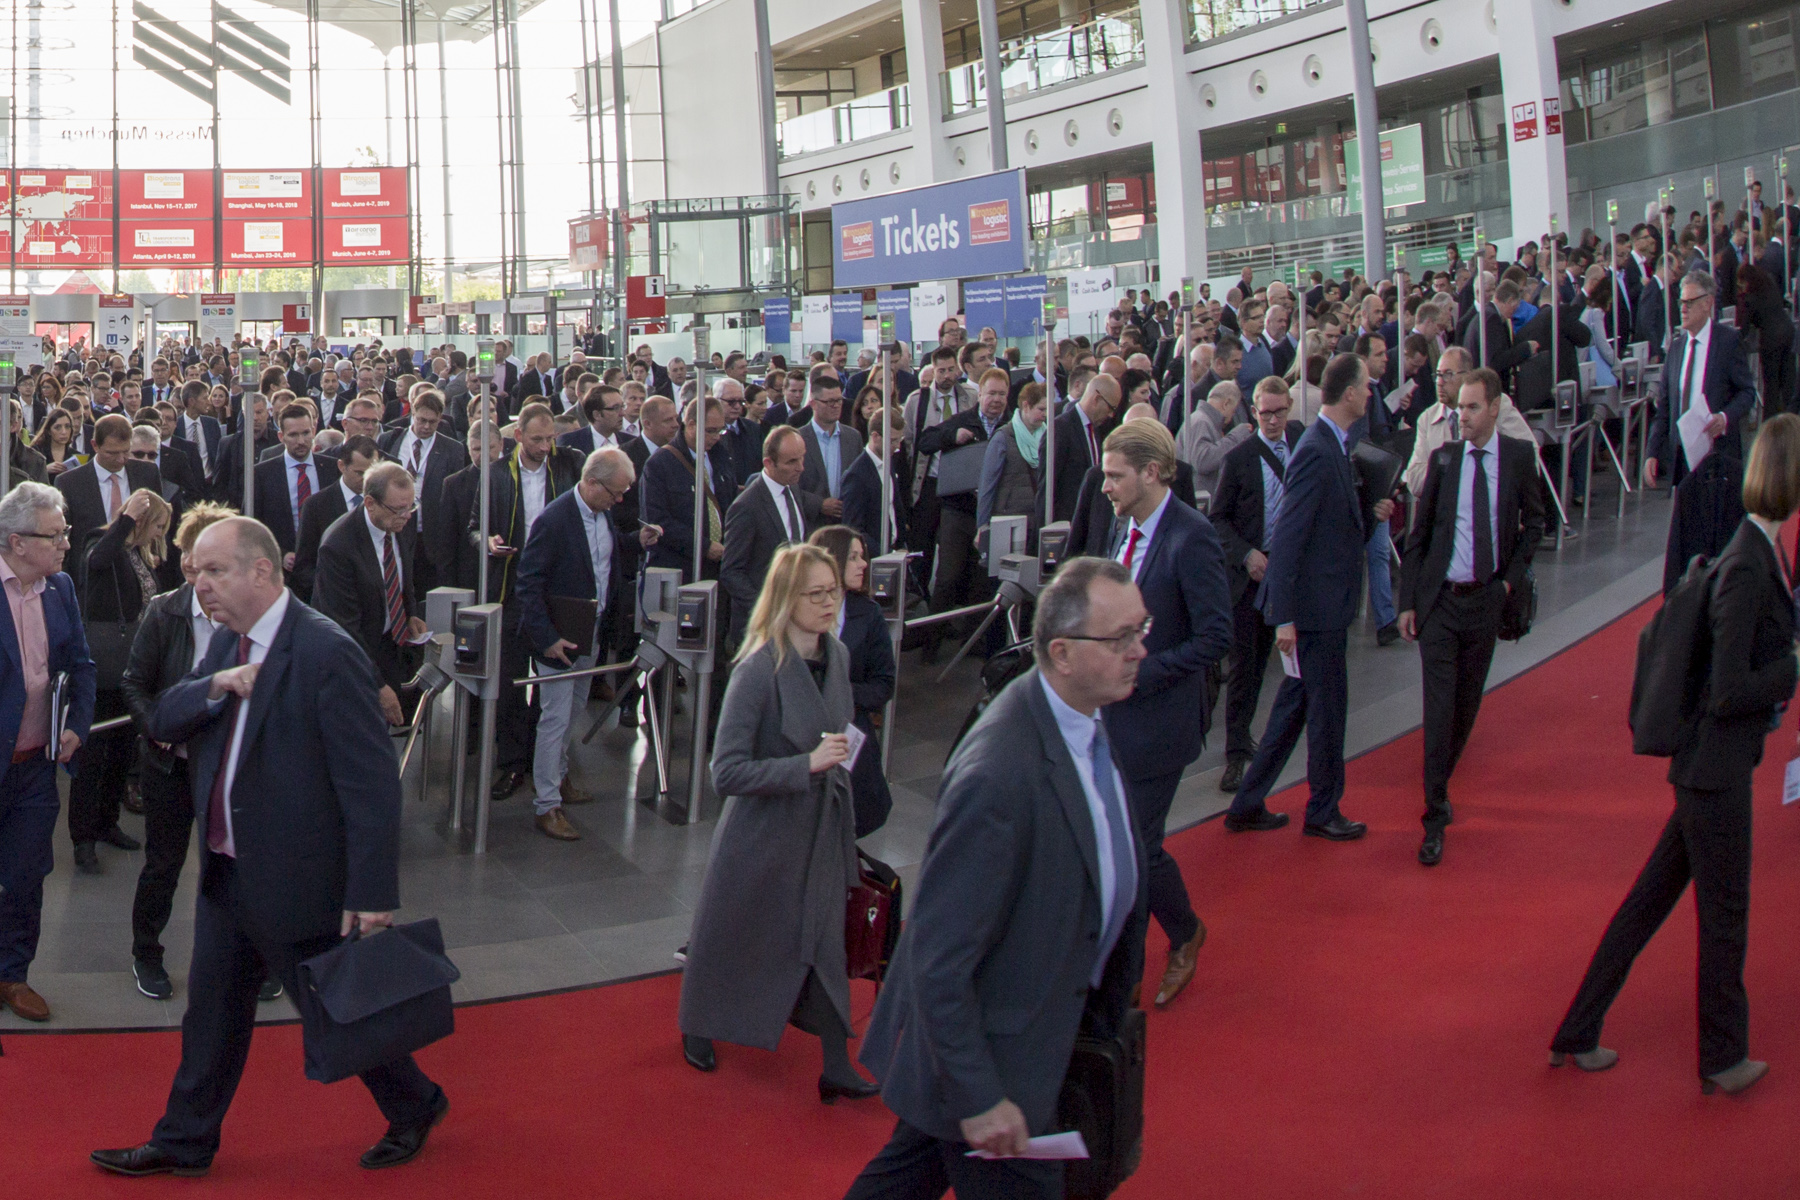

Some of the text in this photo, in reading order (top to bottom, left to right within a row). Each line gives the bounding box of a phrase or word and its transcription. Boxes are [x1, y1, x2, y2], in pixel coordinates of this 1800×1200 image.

[976, 203, 1007, 218] transport
[983, 213, 1007, 227] logistic
[852, 233, 872, 245] logistic
[881, 208, 960, 256] Tickets
